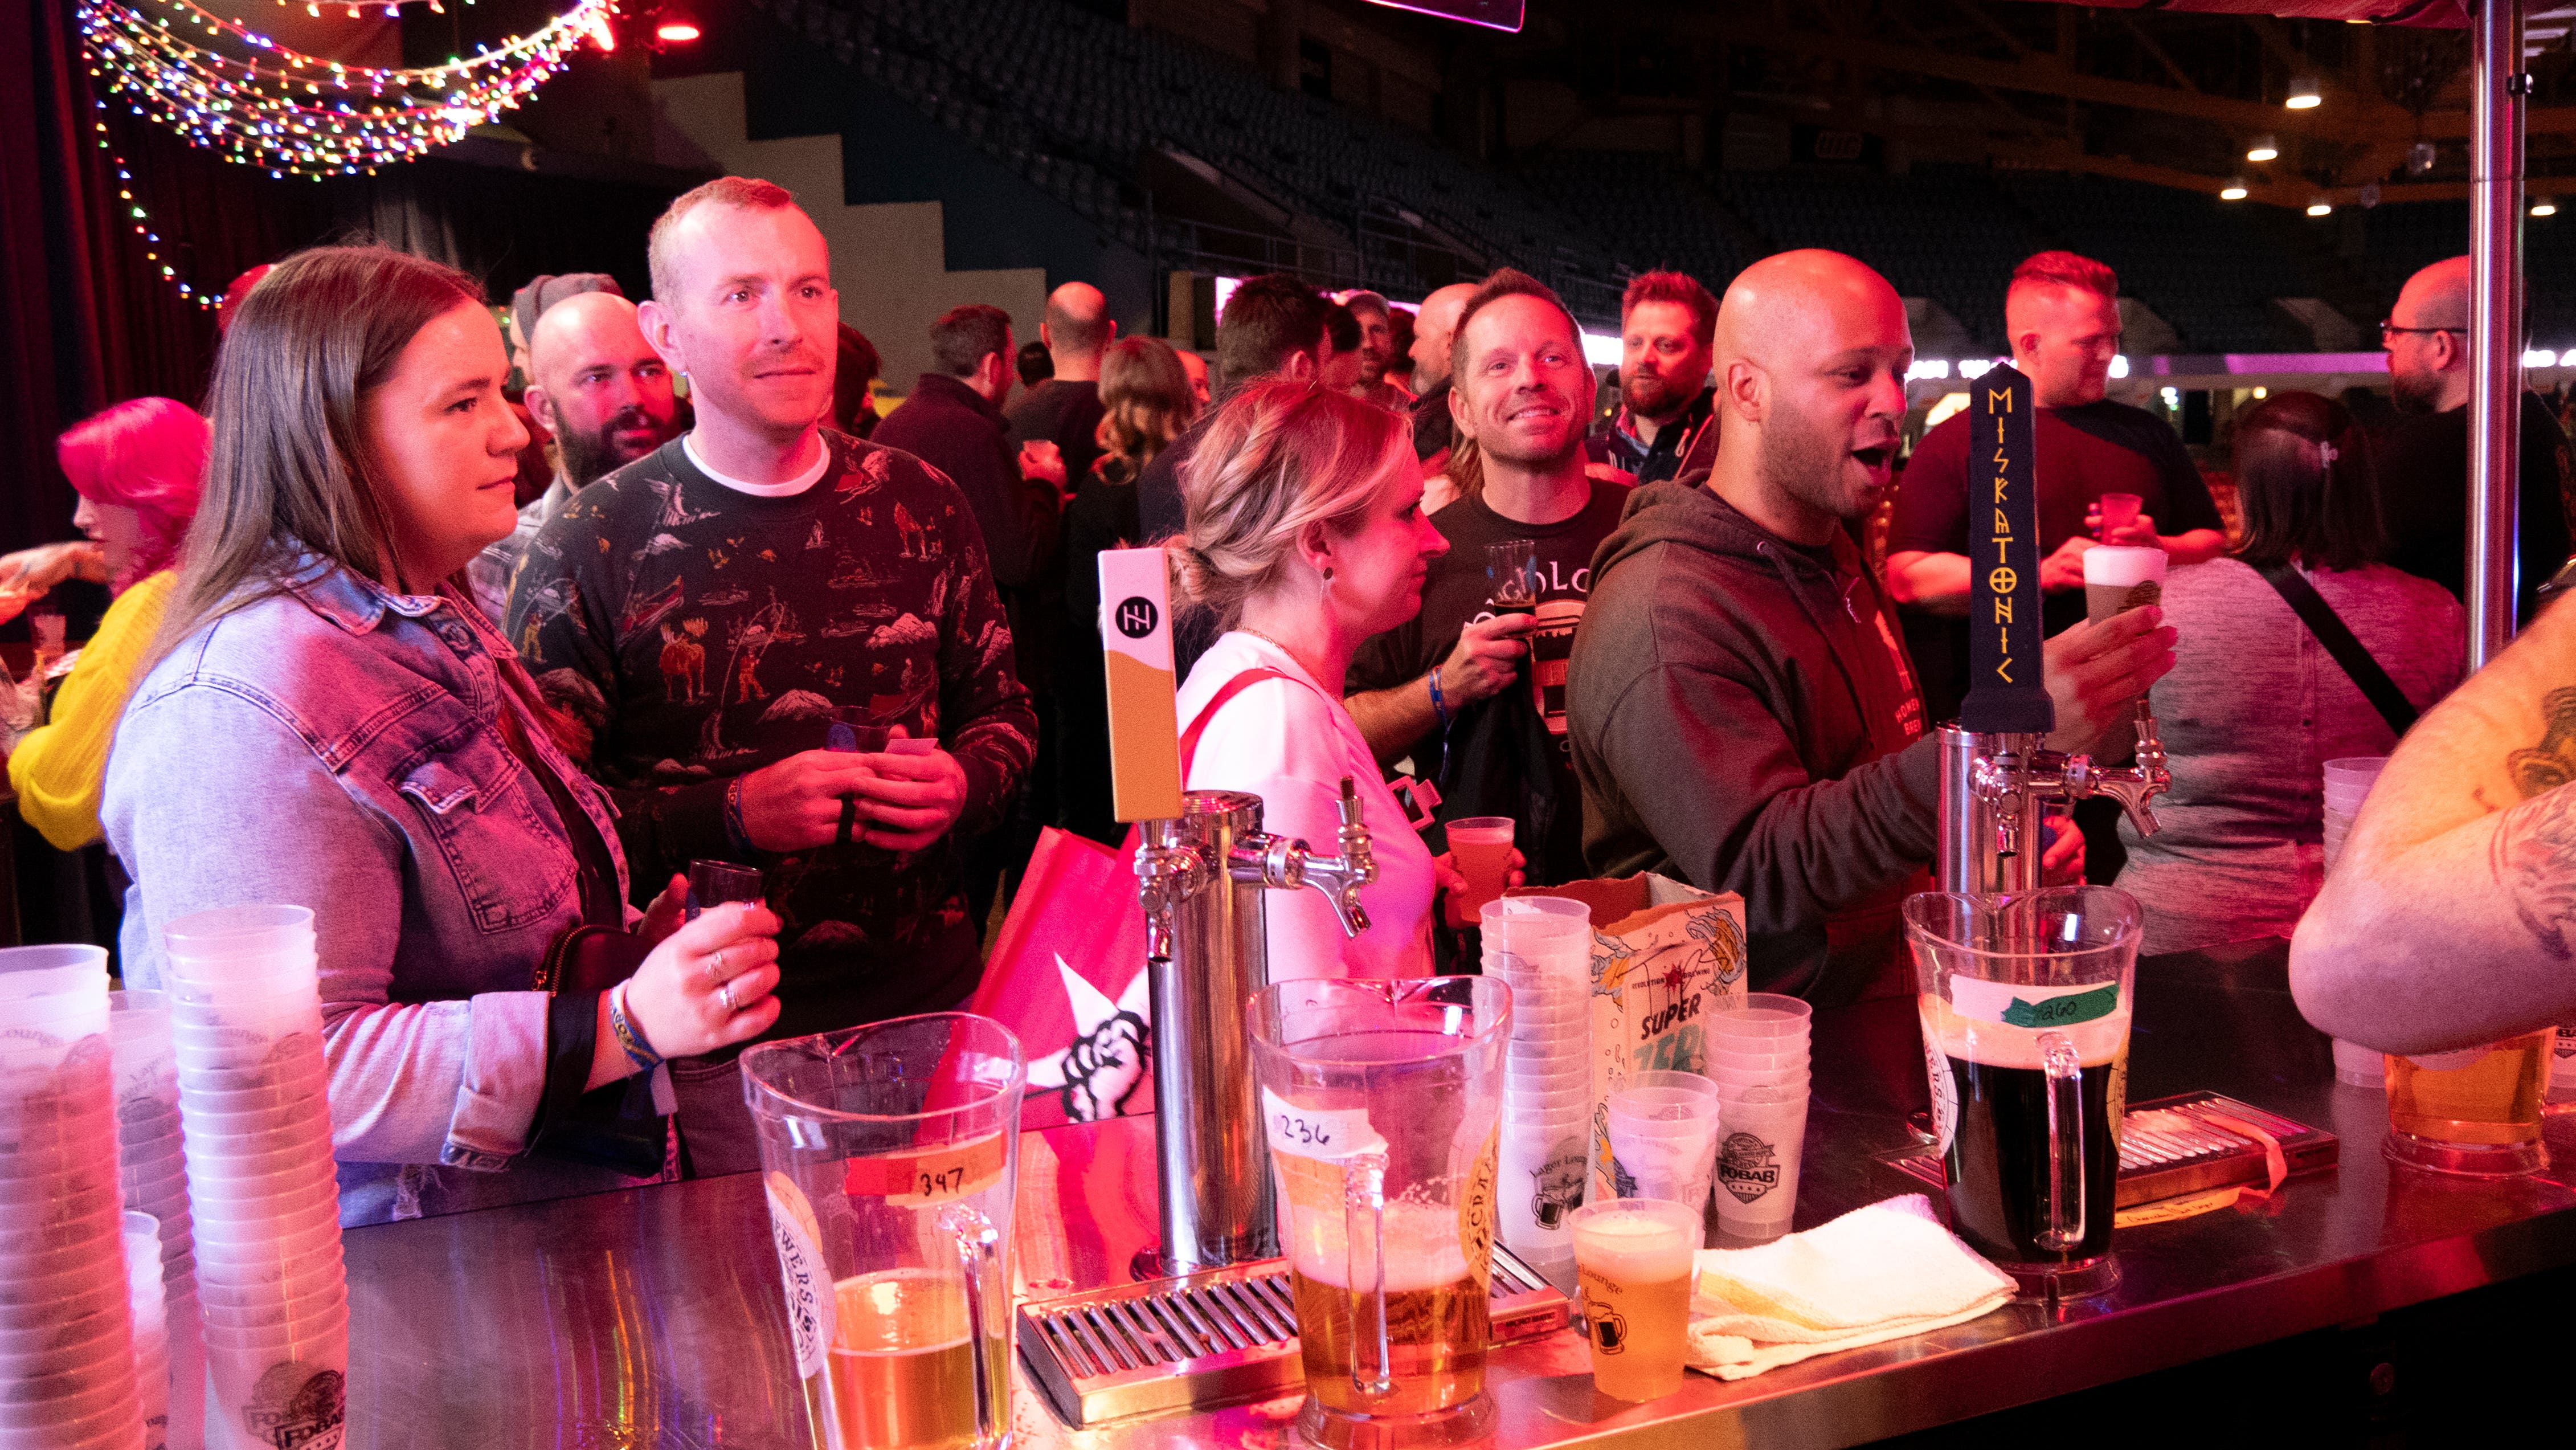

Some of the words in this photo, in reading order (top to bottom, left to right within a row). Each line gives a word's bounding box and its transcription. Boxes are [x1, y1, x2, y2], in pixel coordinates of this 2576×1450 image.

[1641, 992, 1702, 1040] SUPER
[1281, 1114, 1331, 1146] 236
[920, 1167, 964, 1196] 347
[1720, 1163, 1775, 1183] FOBAB
[1581, 1262, 1624, 1296] Lounge
